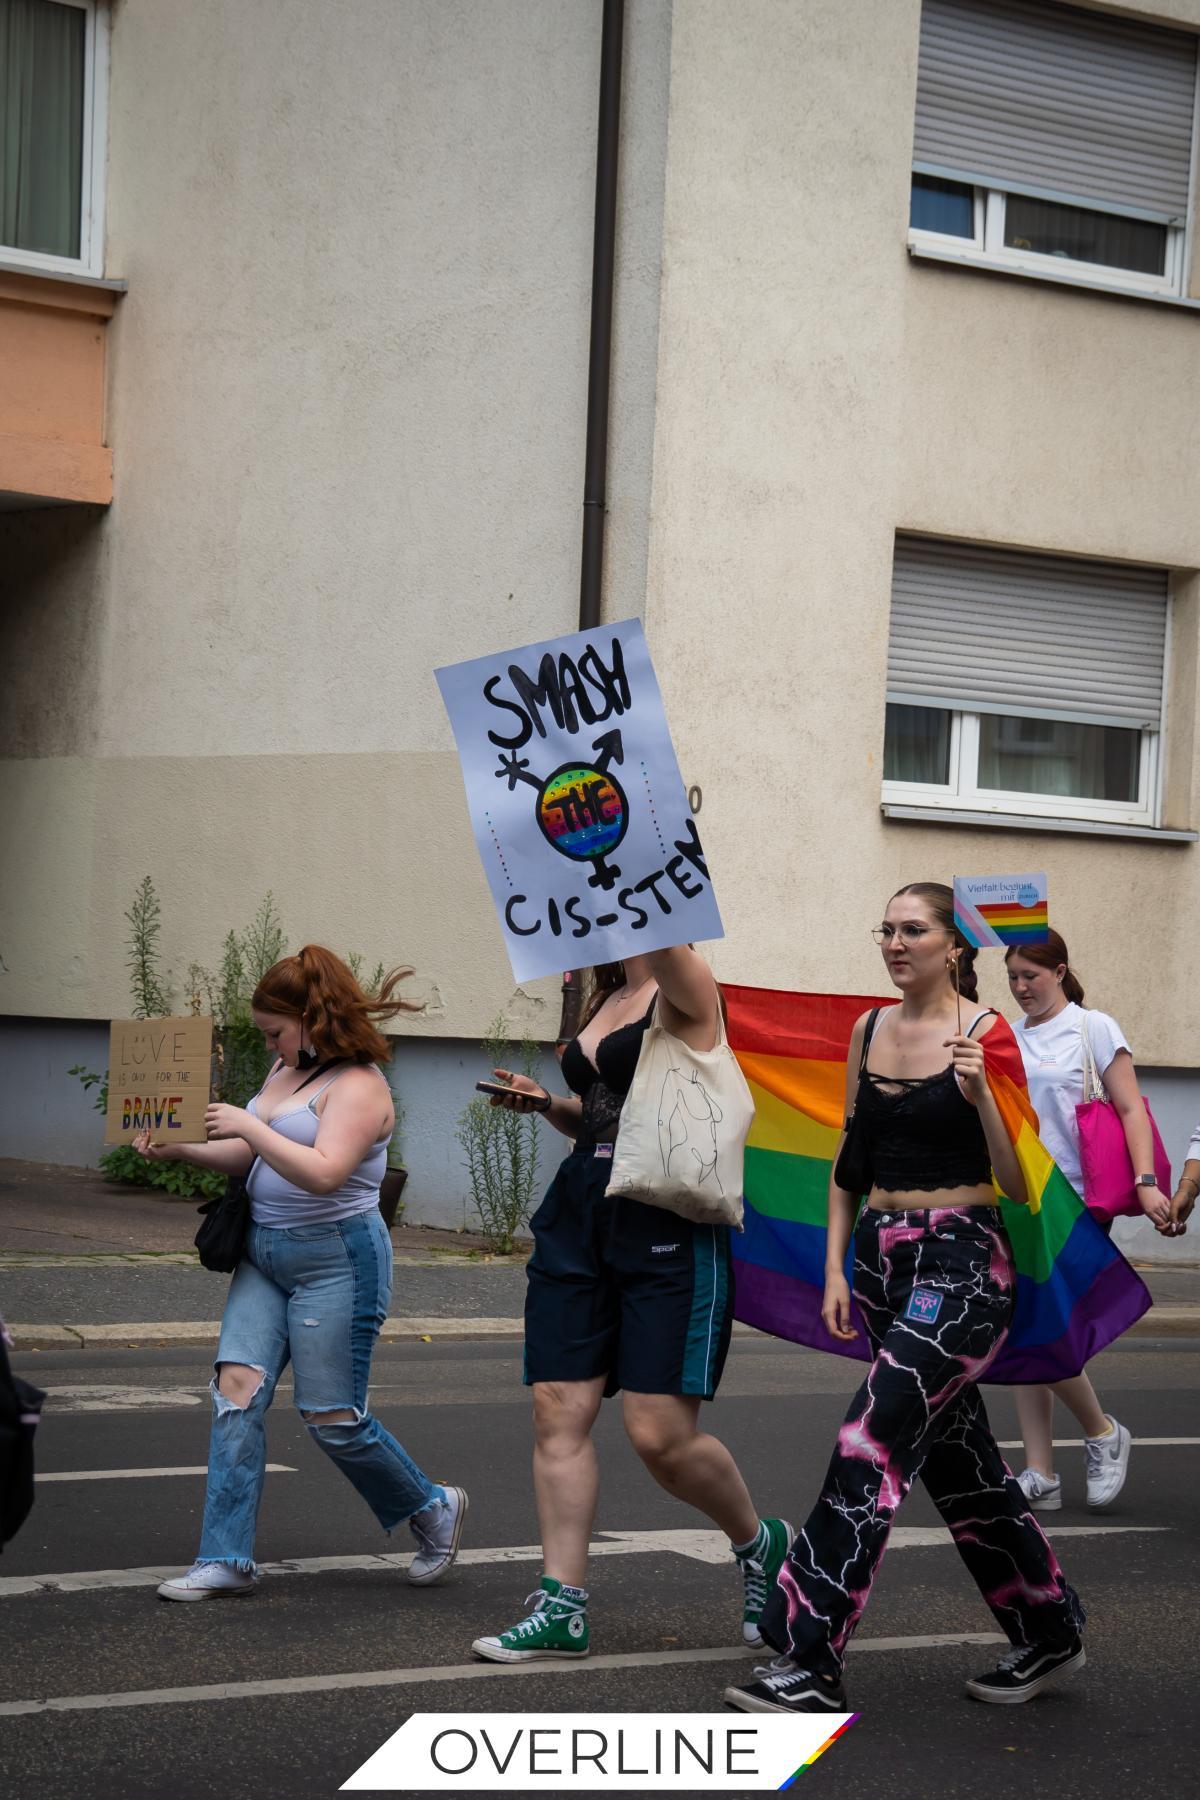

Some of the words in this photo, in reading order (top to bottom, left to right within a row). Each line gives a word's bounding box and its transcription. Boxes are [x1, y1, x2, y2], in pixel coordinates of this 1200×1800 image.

[483, 638, 632, 750] SMASH
[545, 779, 618, 833] THE
[967, 883, 997, 893] Vielfalt
[155, 1071, 172, 1082] FOR
[175, 1071, 191, 1083] THE
[122, 1096, 183, 1130] BRAVE
